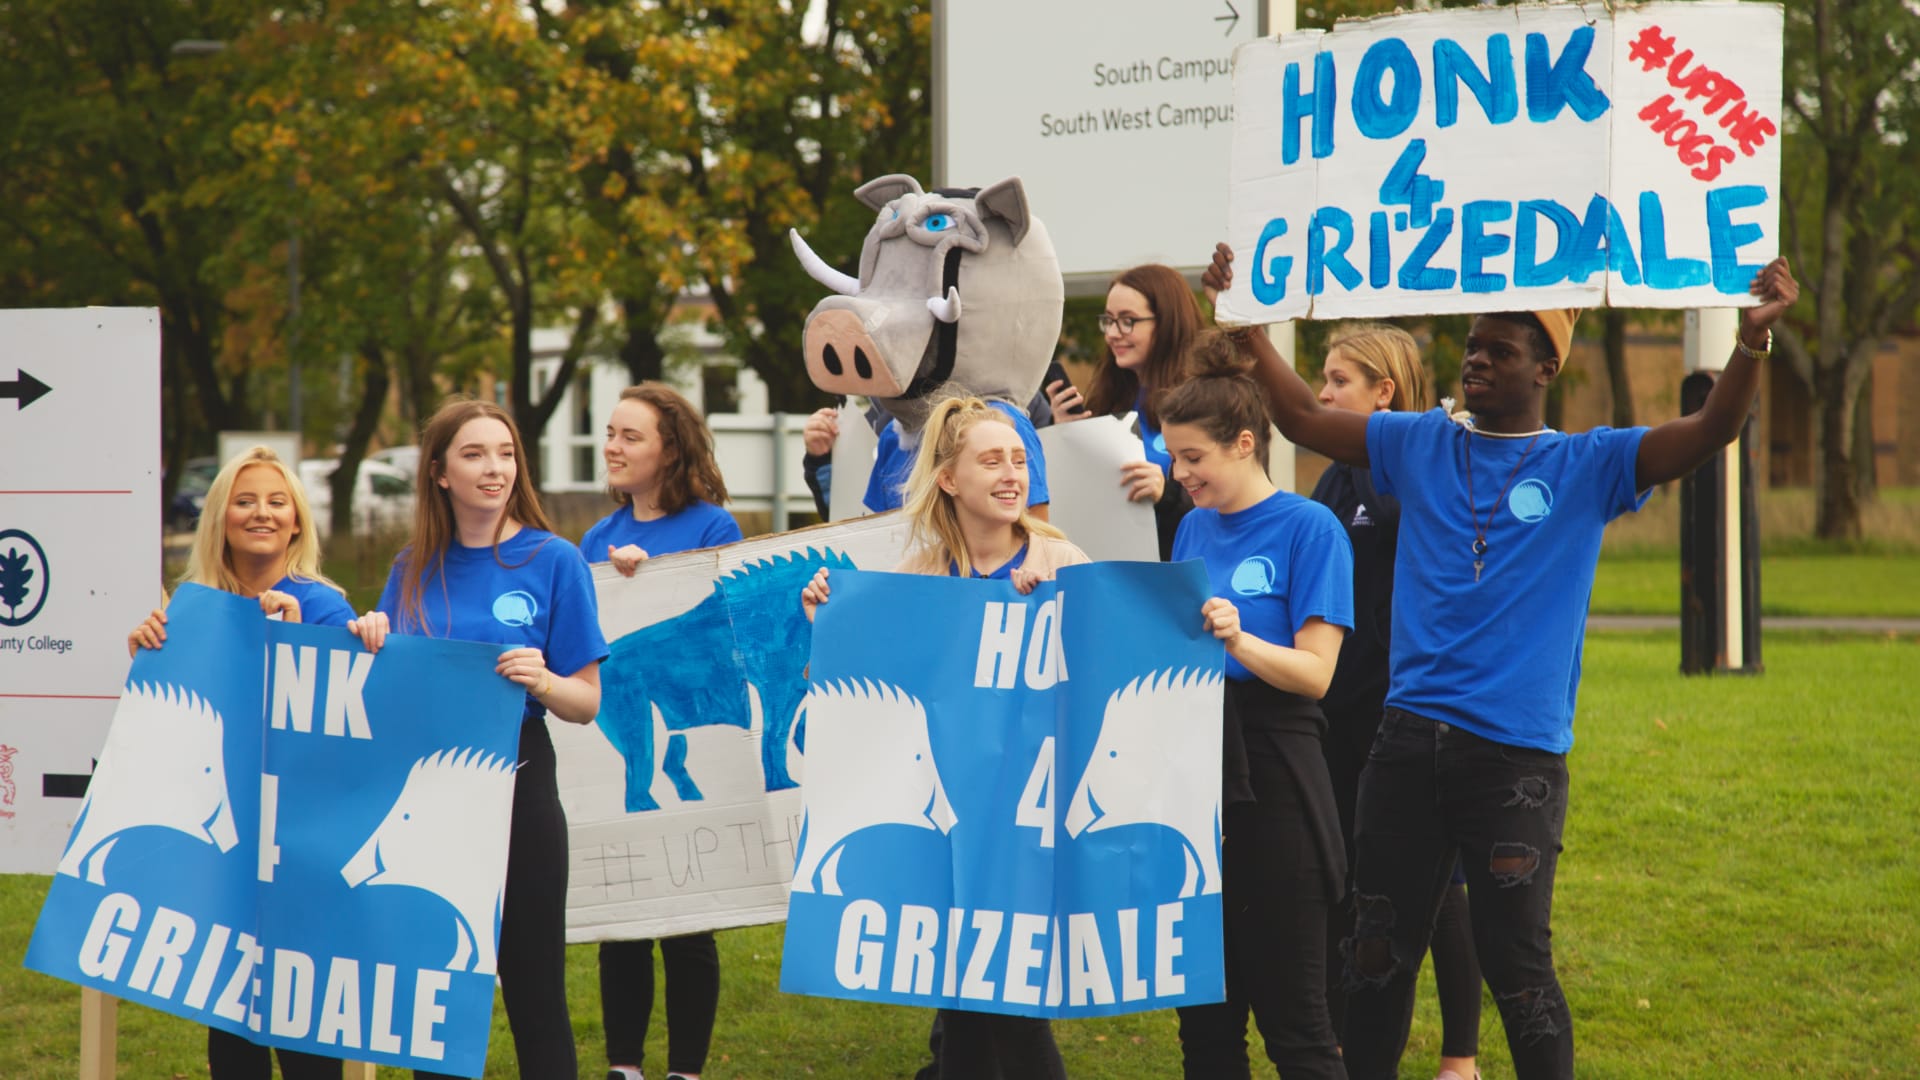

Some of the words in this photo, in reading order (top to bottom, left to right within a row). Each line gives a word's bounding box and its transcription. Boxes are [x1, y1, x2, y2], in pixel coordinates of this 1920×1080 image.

[1040, 112, 1098, 137] South
[1102, 107, 1152, 131] West
[1094, 60, 1152, 87] South
[1282, 26, 1611, 165] HONK
[1628, 25, 1777, 157] #UPTHE
[1379, 139, 1445, 229] 4
[1638, 94, 1736, 182] HOGS
[1251, 185, 1769, 305] GRIZEDALE
[27, 635, 73, 655] College
[974, 591, 1069, 691] HO
[263, 642, 376, 740] NK
[1015, 736, 1055, 849] 4
